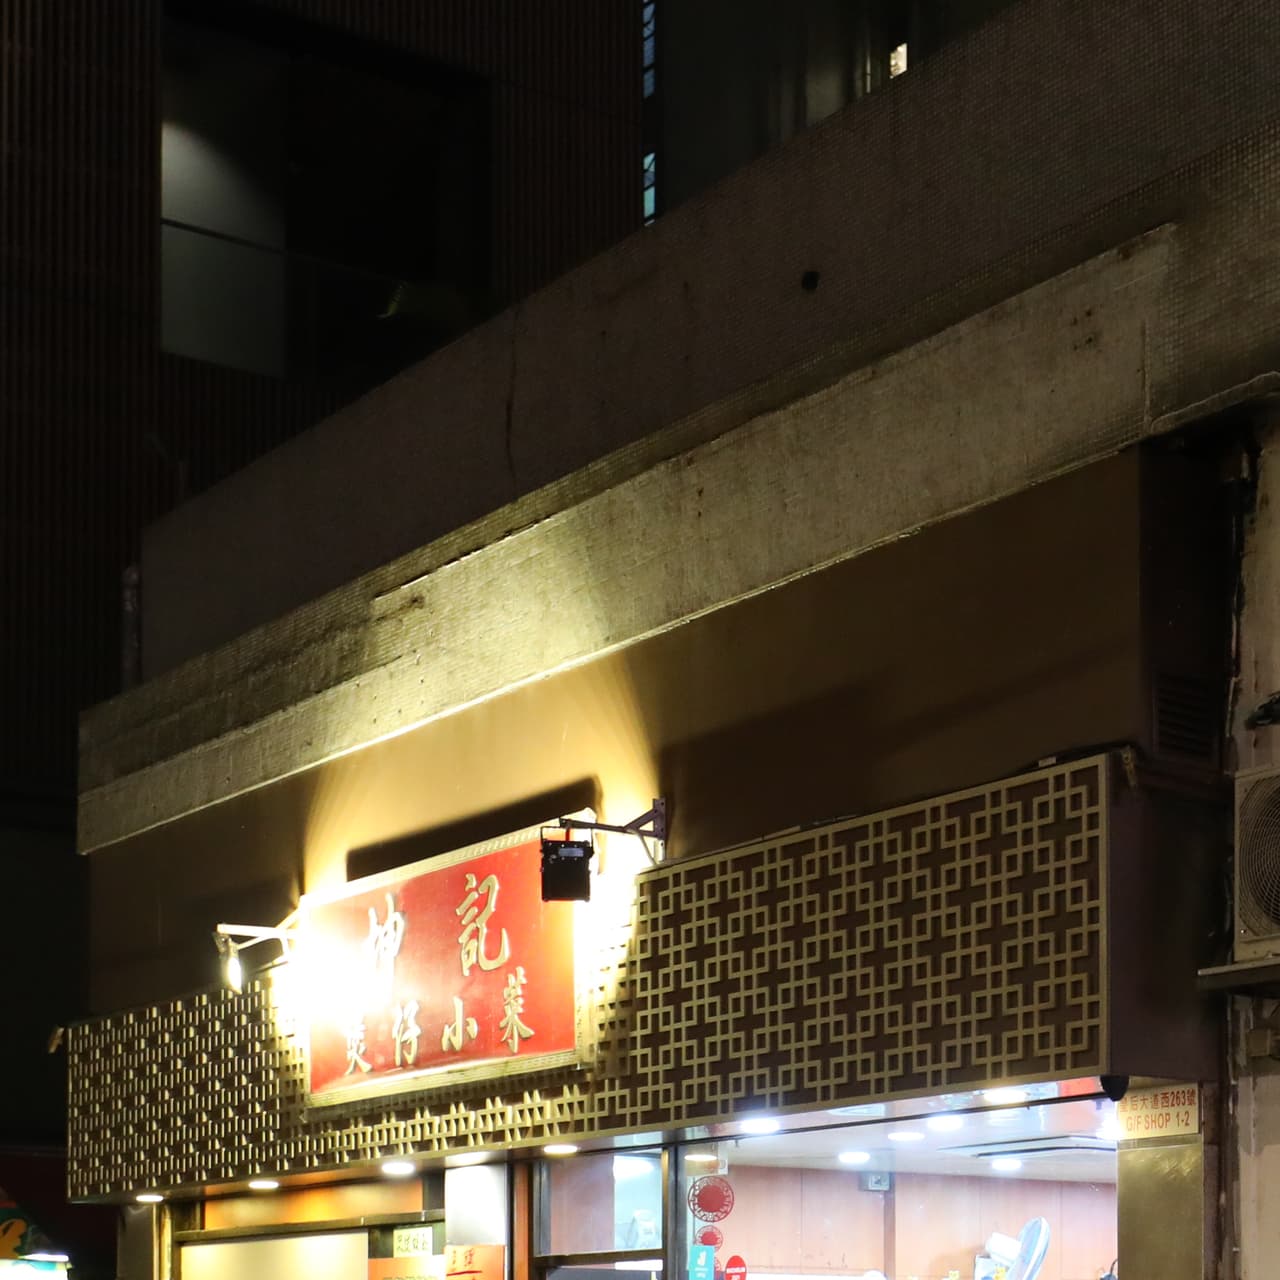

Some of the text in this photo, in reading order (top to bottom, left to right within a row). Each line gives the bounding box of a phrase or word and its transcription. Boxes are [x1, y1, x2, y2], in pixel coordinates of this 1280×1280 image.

[1120, 1087, 1196, 1113] 皇后大道西263號
[1126, 1110, 1190, 1132] G/F SHOP 1-2
